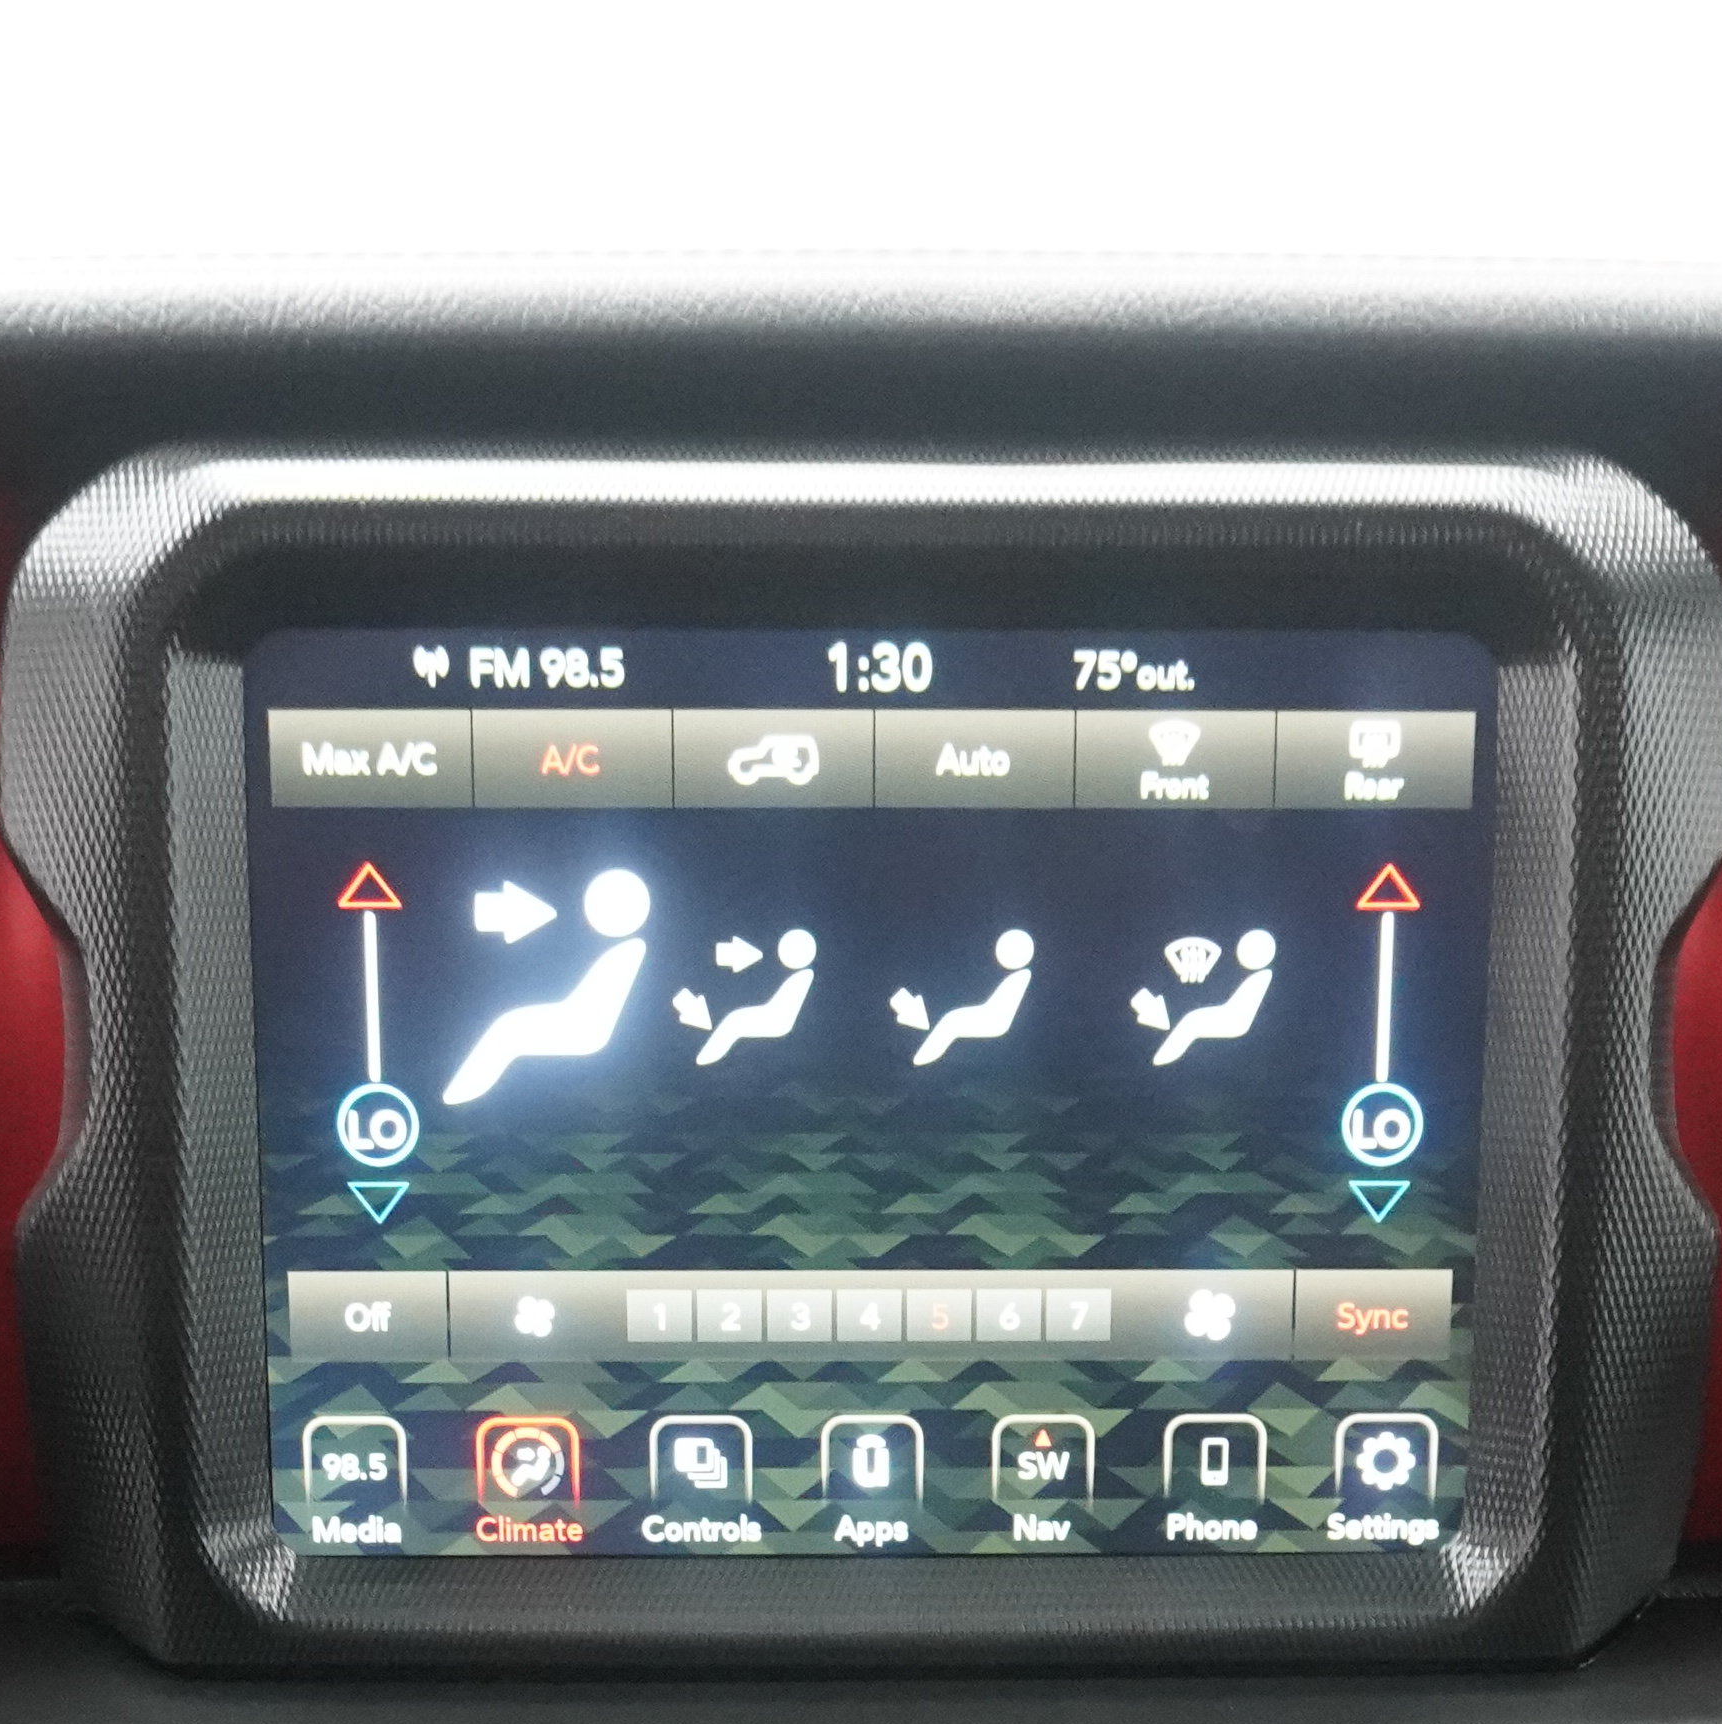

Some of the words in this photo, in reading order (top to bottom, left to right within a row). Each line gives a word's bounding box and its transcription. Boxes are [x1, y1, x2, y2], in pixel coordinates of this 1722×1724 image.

[470, 648, 531, 689] FM
[539, 647, 625, 689] 98.5
[828, 641, 933, 694] 1:30
[302, 742, 370, 776] Max
[376, 742, 437, 777] A/C
[541, 744, 602, 776] A/C
[936, 743, 1011, 778] Auto
[1140, 772, 1210, 801] Front
[1343, 772, 1405, 801] Rear
[346, 1107, 408, 1152] LO
[1351, 1110, 1411, 1150] LO
[345, 1302, 393, 1333] Off
[653, 1304, 667, 1332] 1
[720, 1304, 742, 1332] 2
[790, 1304, 811, 1332] 3
[859, 1303, 883, 1333] 4
[931, 1303, 949, 1331] 5
[999, 1303, 1020, 1331] 6
[1070, 1302, 1088, 1331] 7
[1336, 1302, 1409, 1337] Sync
[321, 1452, 389, 1483] 98.5
[1017, 1451, 1071, 1481] SW
[311, 1516, 403, 1545] Media
[476, 1516, 585, 1544] Climate
[641, 1514, 762, 1544] Controls
[834, 1515, 910, 1547] Apps
[1013, 1515, 1072, 1542] Nav
[1165, 1514, 1258, 1542] Phone
[1327, 1514, 1441, 1544] Settings
